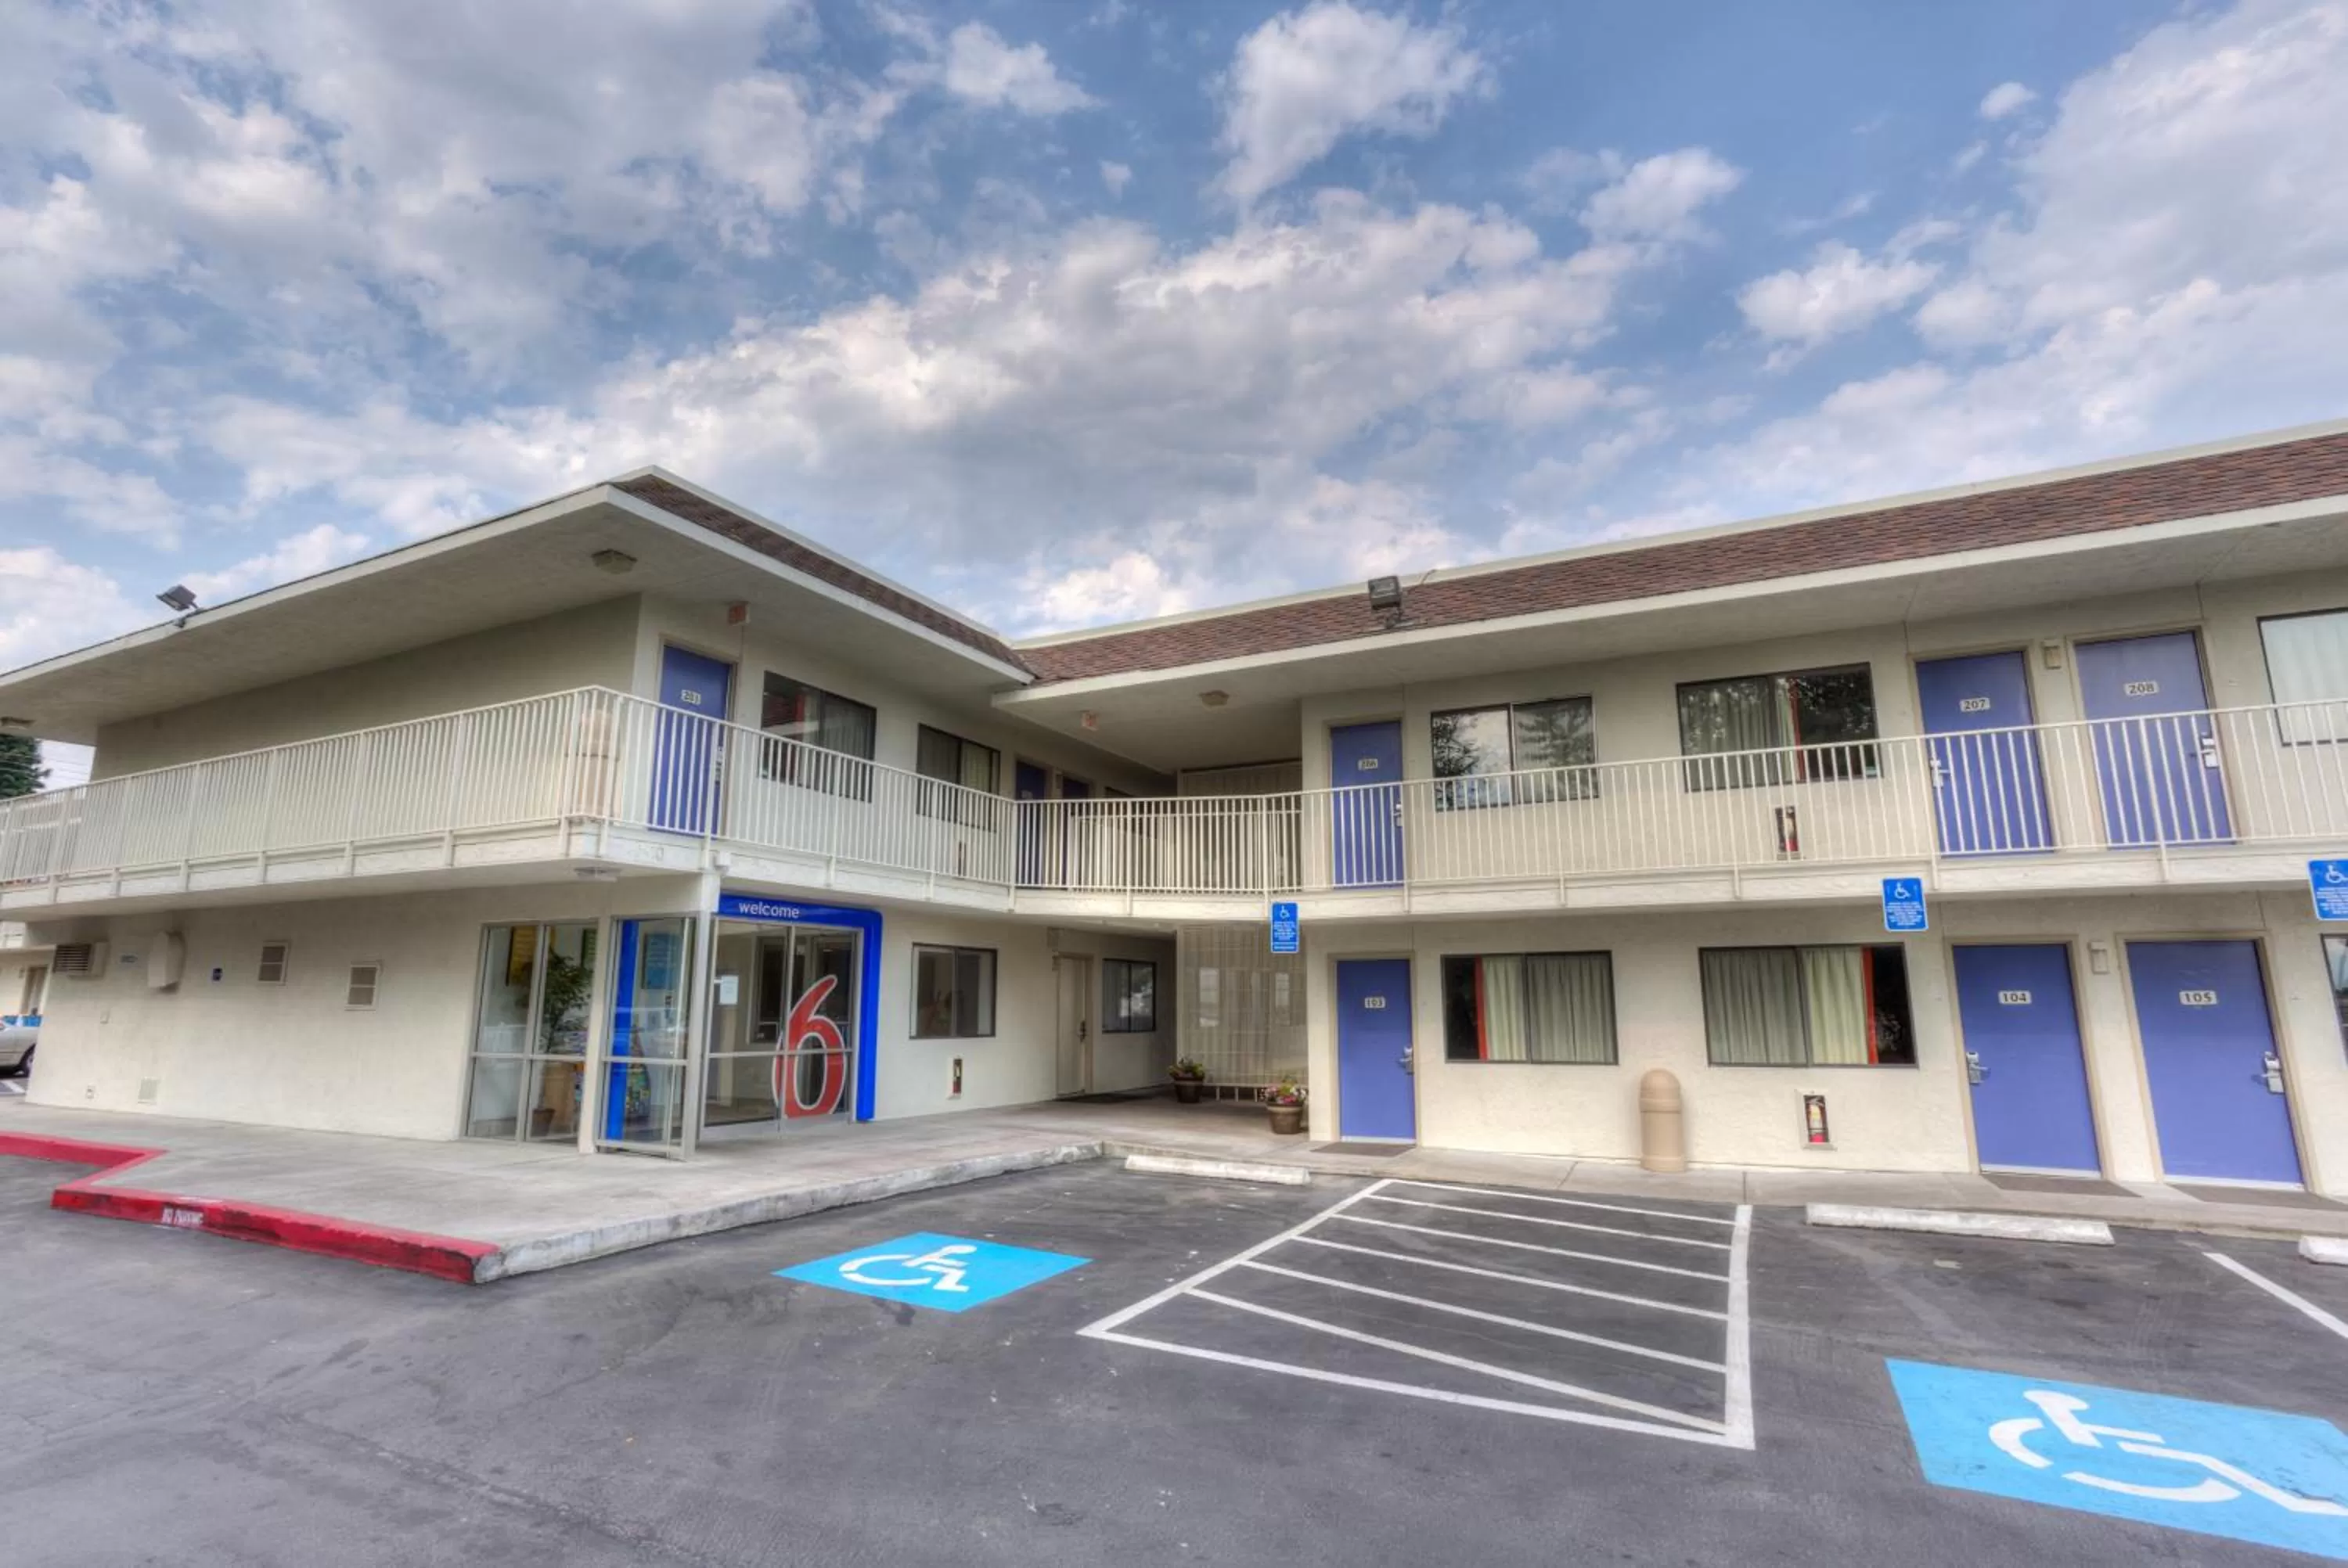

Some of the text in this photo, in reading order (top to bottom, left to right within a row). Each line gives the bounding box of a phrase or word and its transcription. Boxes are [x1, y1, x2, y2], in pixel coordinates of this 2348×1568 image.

[2128, 683, 2155, 694] 208
[1964, 699, 1986, 710] 207
[738, 901, 799, 919] welcome
[2004, 993, 2026, 1002] 104
[2184, 992, 2212, 1002] 105
[772, 974, 846, 1118] 6
